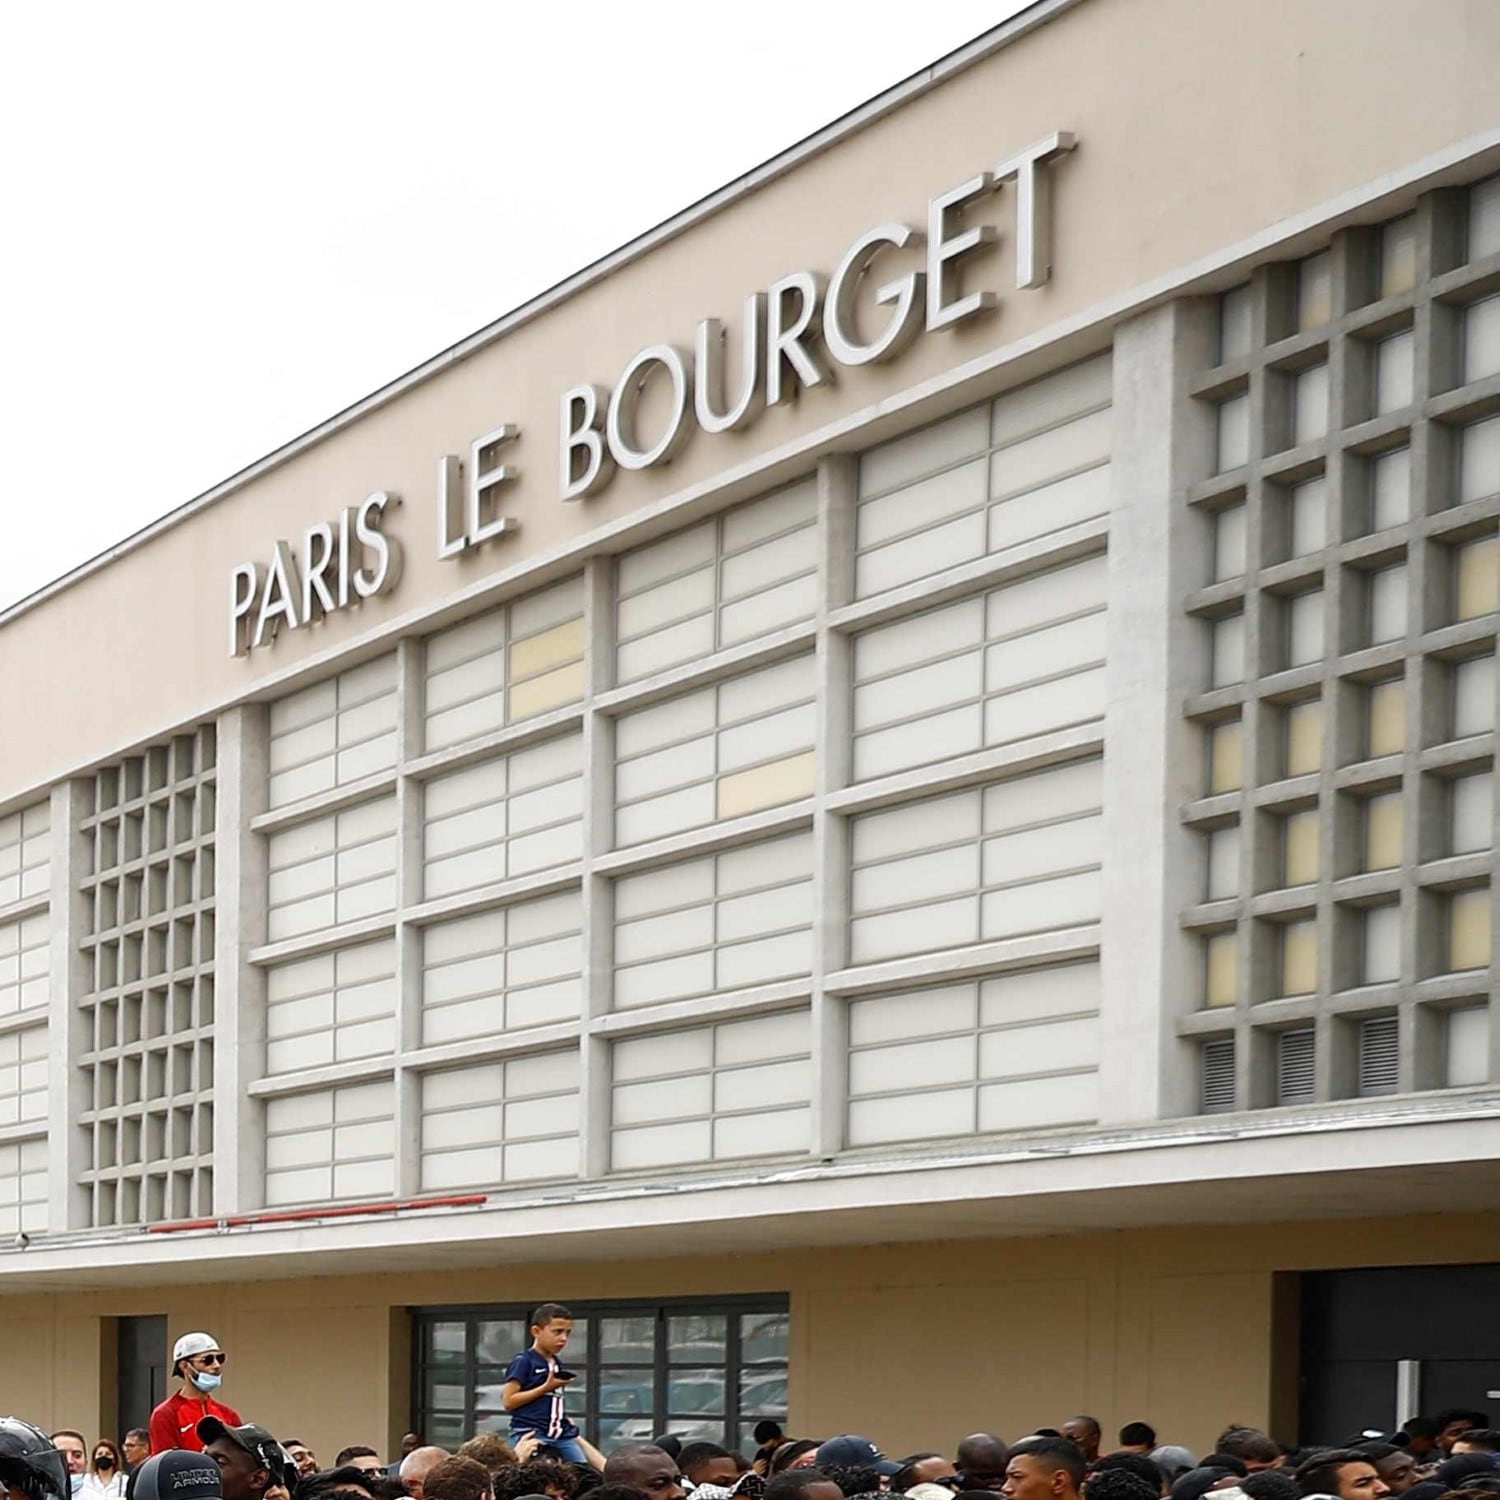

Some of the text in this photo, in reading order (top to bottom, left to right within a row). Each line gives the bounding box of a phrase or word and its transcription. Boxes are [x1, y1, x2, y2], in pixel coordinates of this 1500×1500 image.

[228, 131, 1078, 658] PARIS LE BOURGET
[171, 1469, 216, 1480] UNDER
[173, 1477, 219, 1489] ARMOUR
